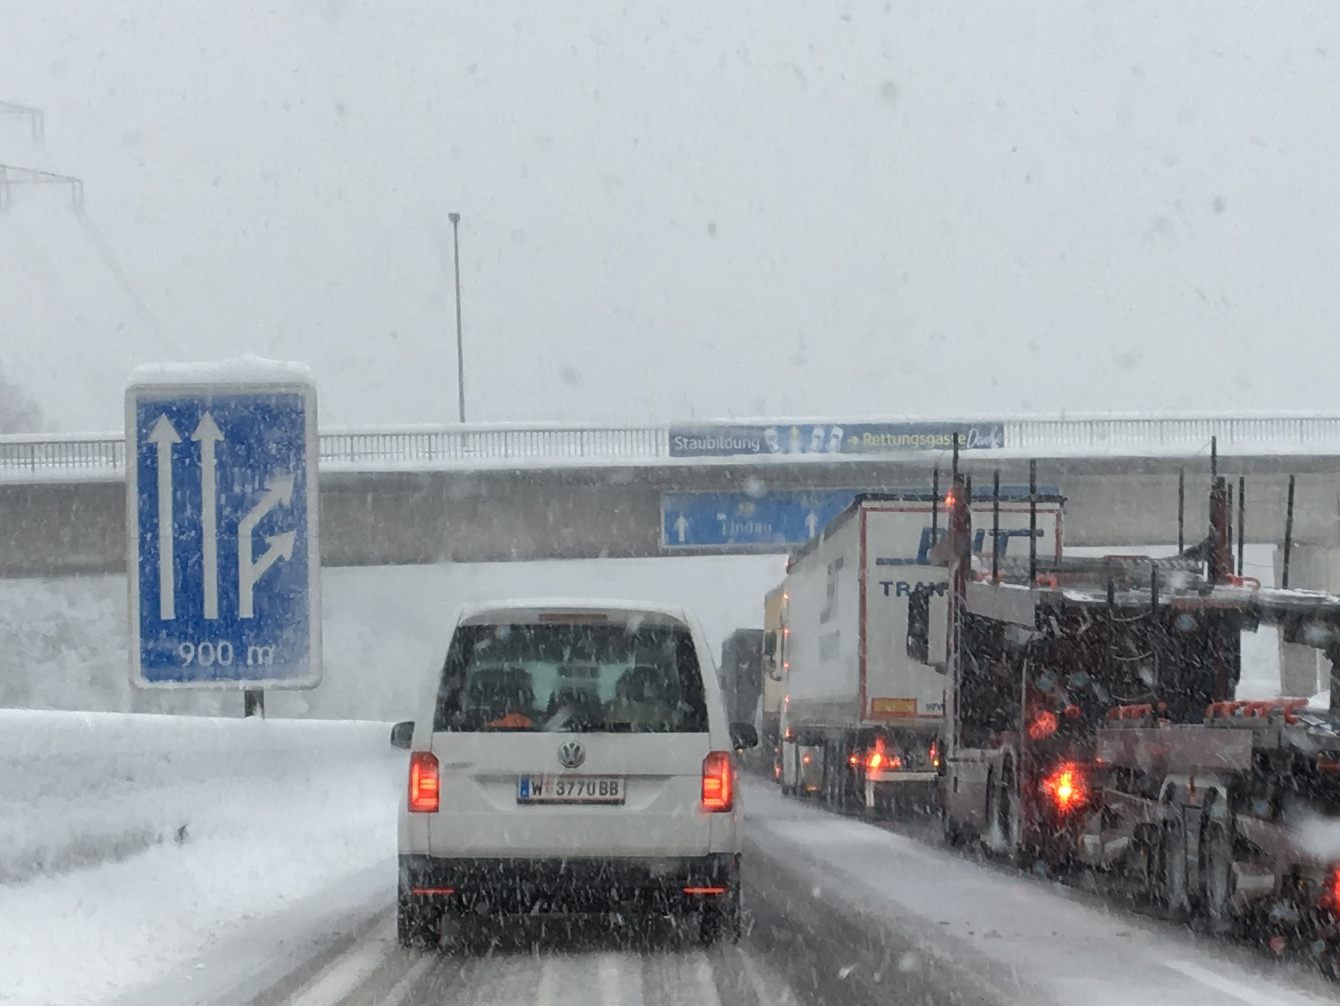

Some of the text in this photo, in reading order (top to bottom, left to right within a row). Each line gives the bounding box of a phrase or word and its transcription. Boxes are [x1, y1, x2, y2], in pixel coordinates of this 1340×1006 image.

[674, 435, 761, 452] Staubildung
[863, 431, 967, 447] Rettungsgase
[180, 641, 275, 667] 900 m
[531, 780, 543, 796] W
